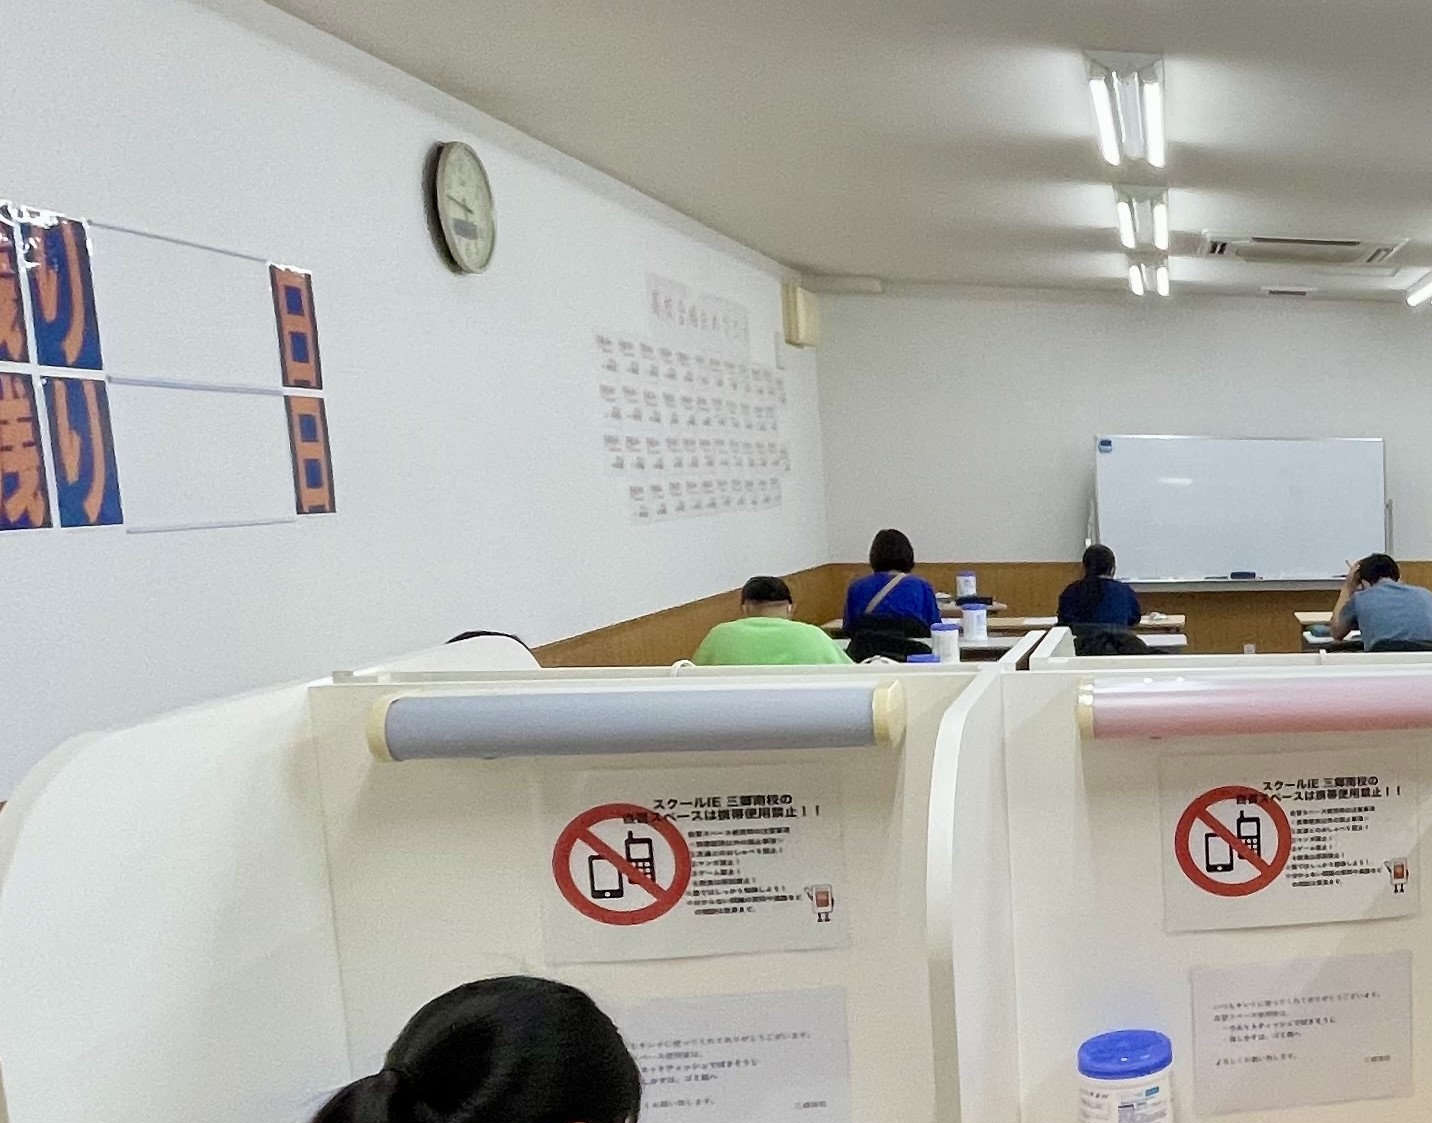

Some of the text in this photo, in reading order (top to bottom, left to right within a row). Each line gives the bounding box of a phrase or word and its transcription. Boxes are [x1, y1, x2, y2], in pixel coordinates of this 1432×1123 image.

[272, 268, 320, 388] 日
[286, 396, 334, 514] 日
[653, 796, 721, 810] スクールIE
